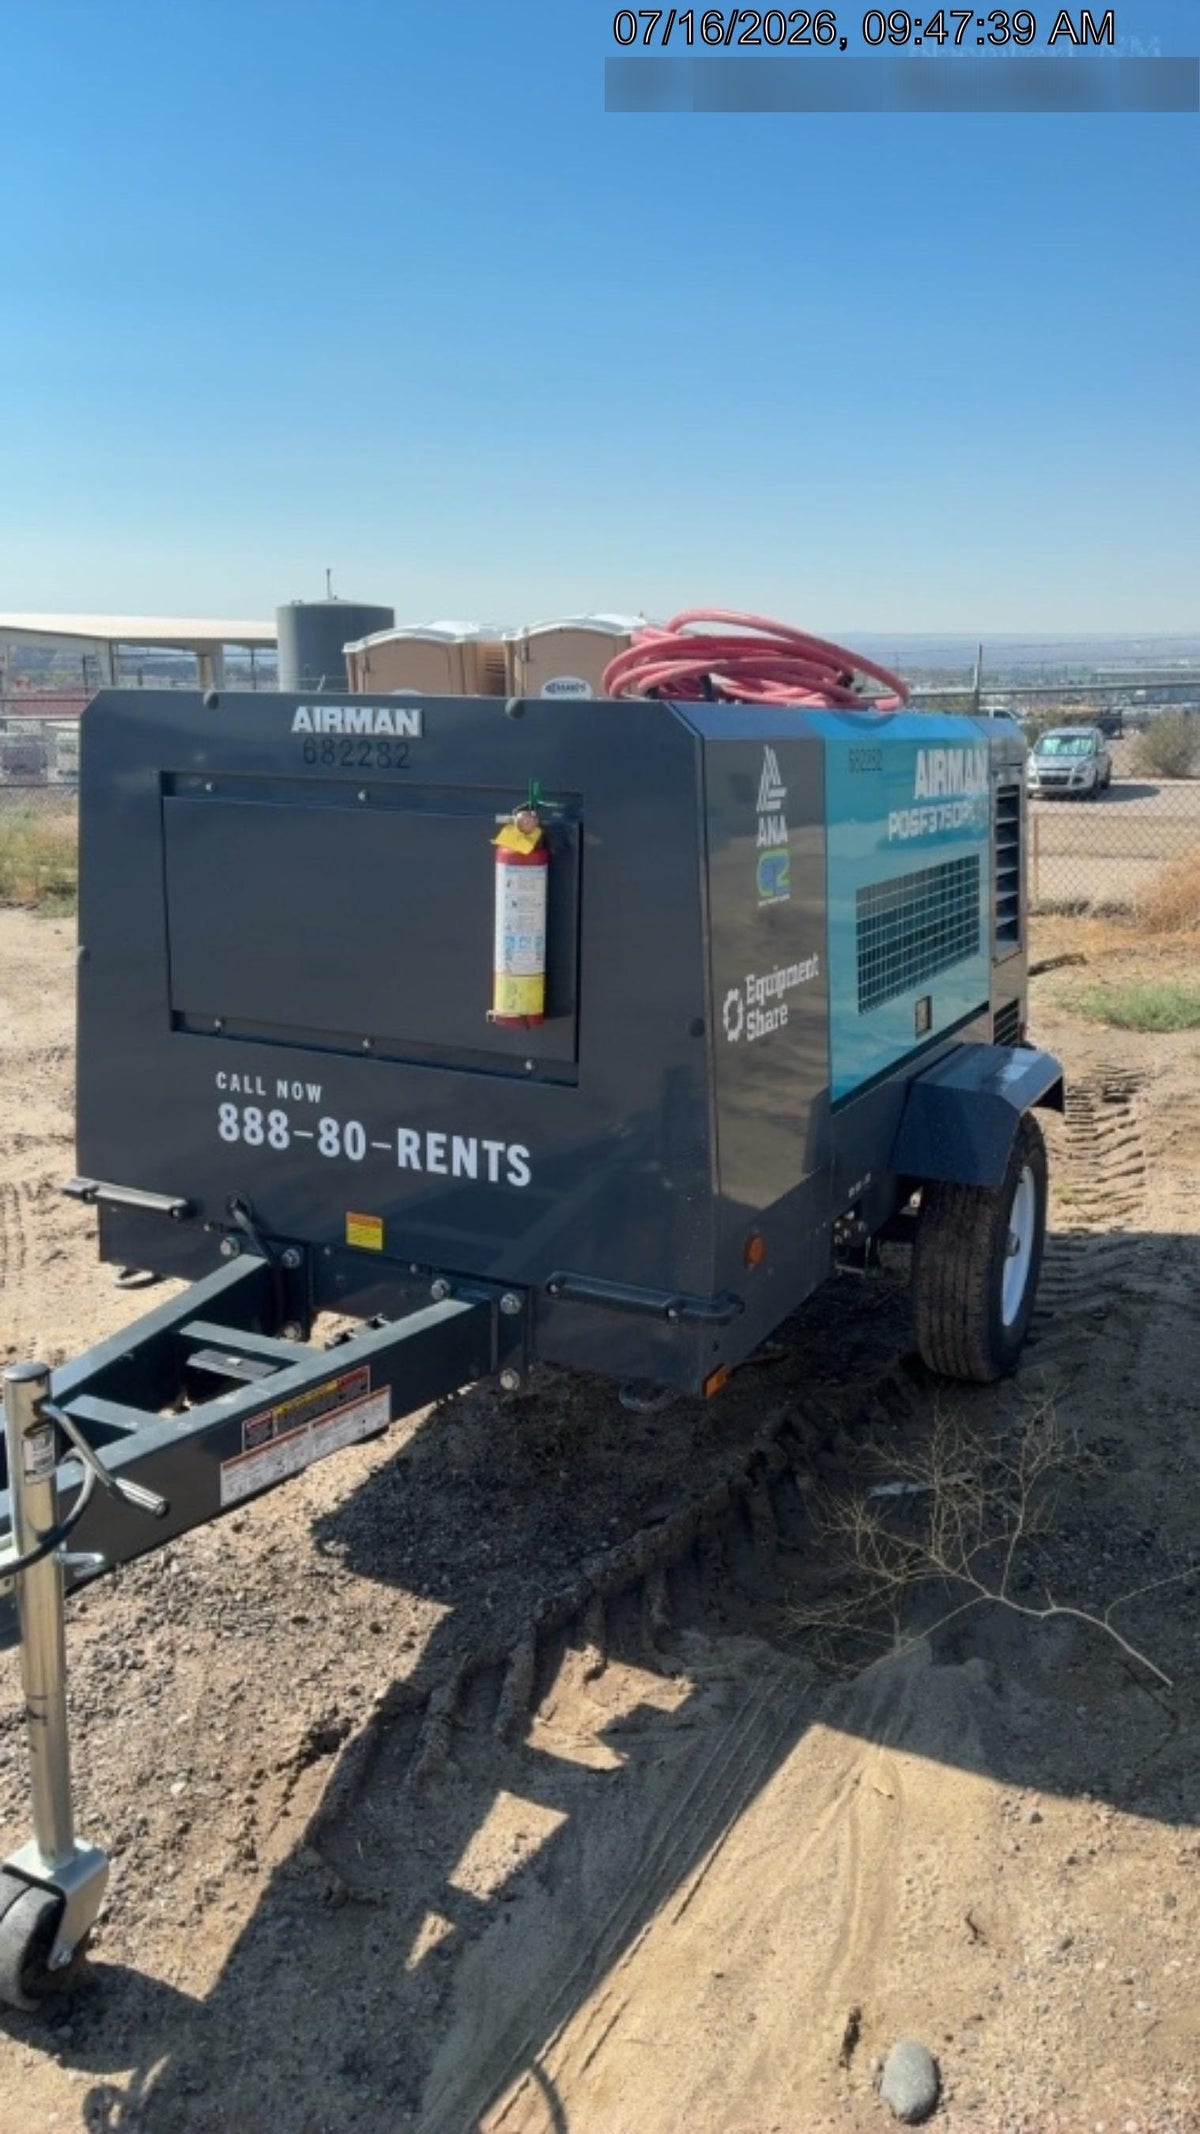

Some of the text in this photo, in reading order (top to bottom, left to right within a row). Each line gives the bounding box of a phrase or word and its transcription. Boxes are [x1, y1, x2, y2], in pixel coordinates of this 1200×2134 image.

[291, 706, 421, 738] AIRMAN
[303, 738, 411, 769] 682282
[913, 749, 990, 800] AIRMAN
[756, 815, 788, 846] ANA
[744, 953, 820, 1006] Equipment
[745, 1002, 788, 1042] Share
[215, 1071, 322, 1104] CALL NOW
[217, 1102, 532, 1187] 888-80-RENTS
